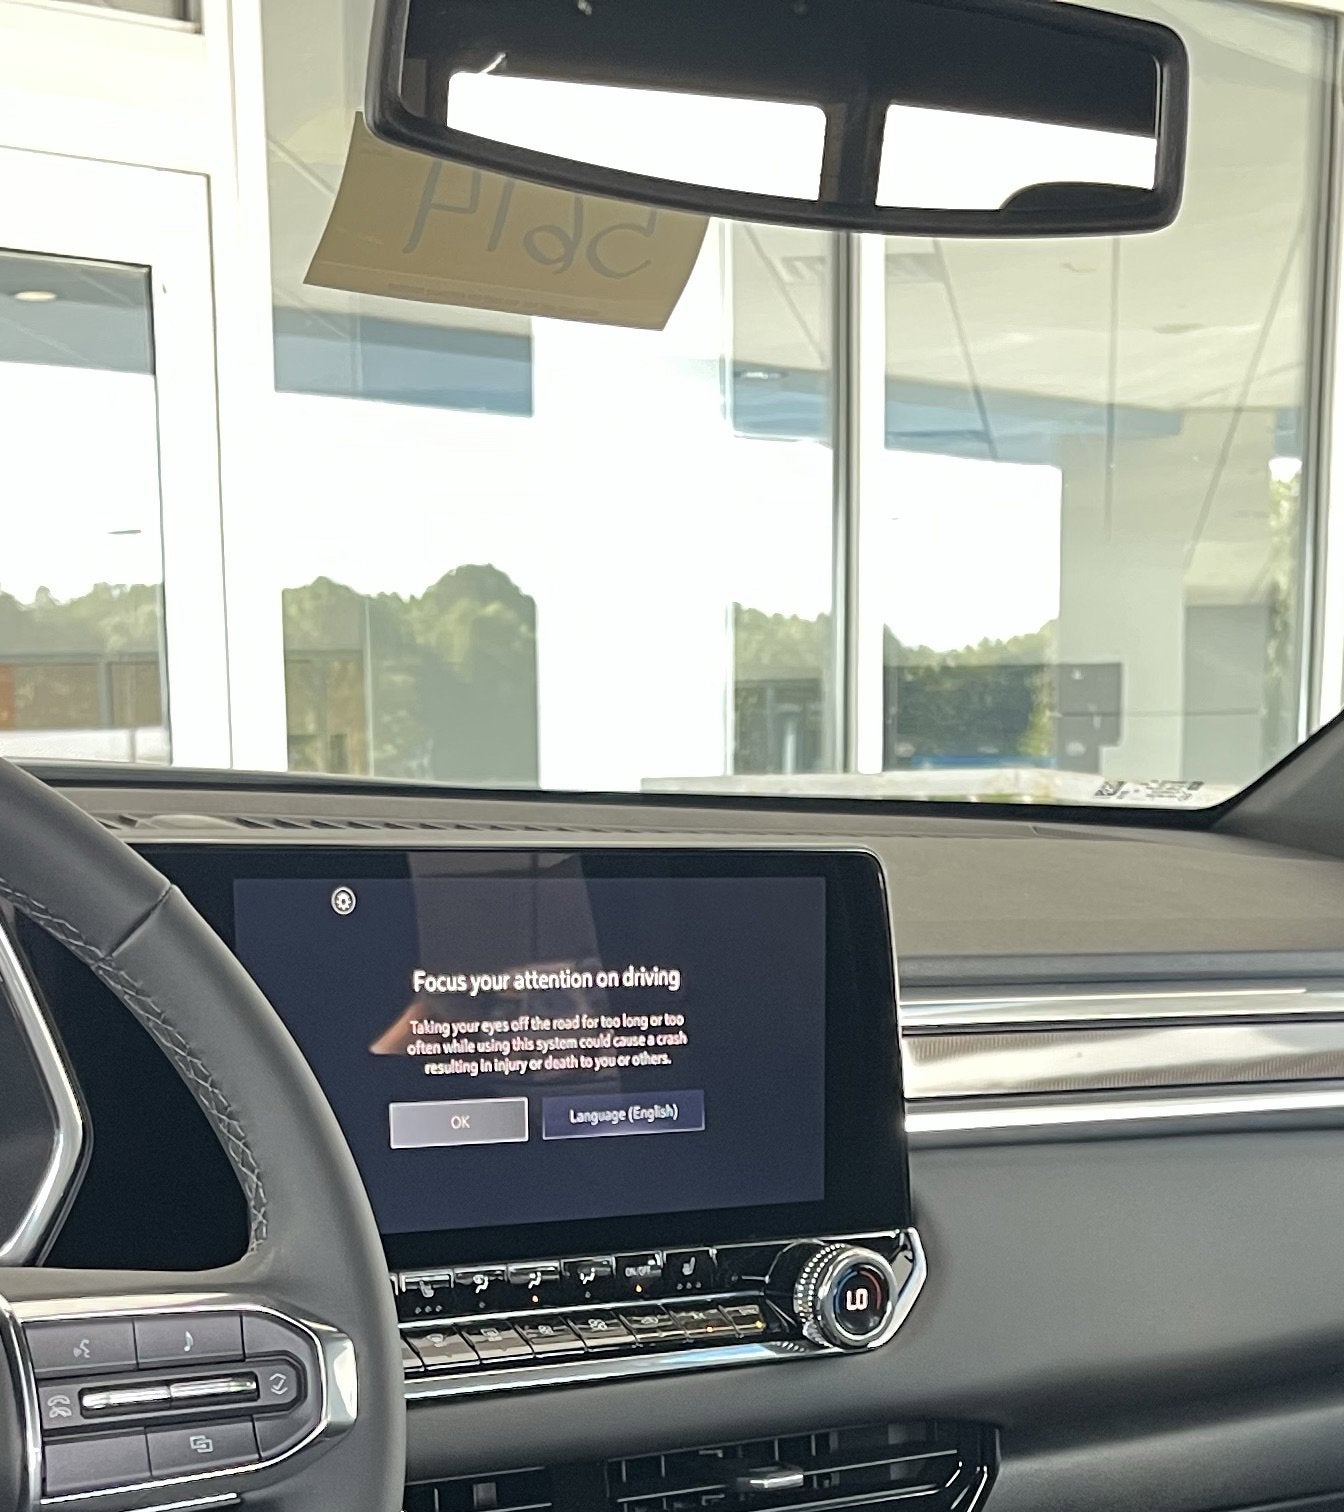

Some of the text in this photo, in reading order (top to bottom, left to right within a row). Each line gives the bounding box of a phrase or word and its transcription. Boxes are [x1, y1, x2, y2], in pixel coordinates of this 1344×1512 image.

[413, 965, 681, 996] Focus your attention on driving
[410, 1013, 685, 1038] Taking your eyes off the road for too long or too
[407, 1030, 689, 1055] often while using this system could cause a crash
[424, 1050, 672, 1076] resulting in injury or death to you or others.
[450, 1115, 471, 1130] OK
[569, 1103, 679, 1126] Language (English)
[846, 1288, 868, 1310] LO
